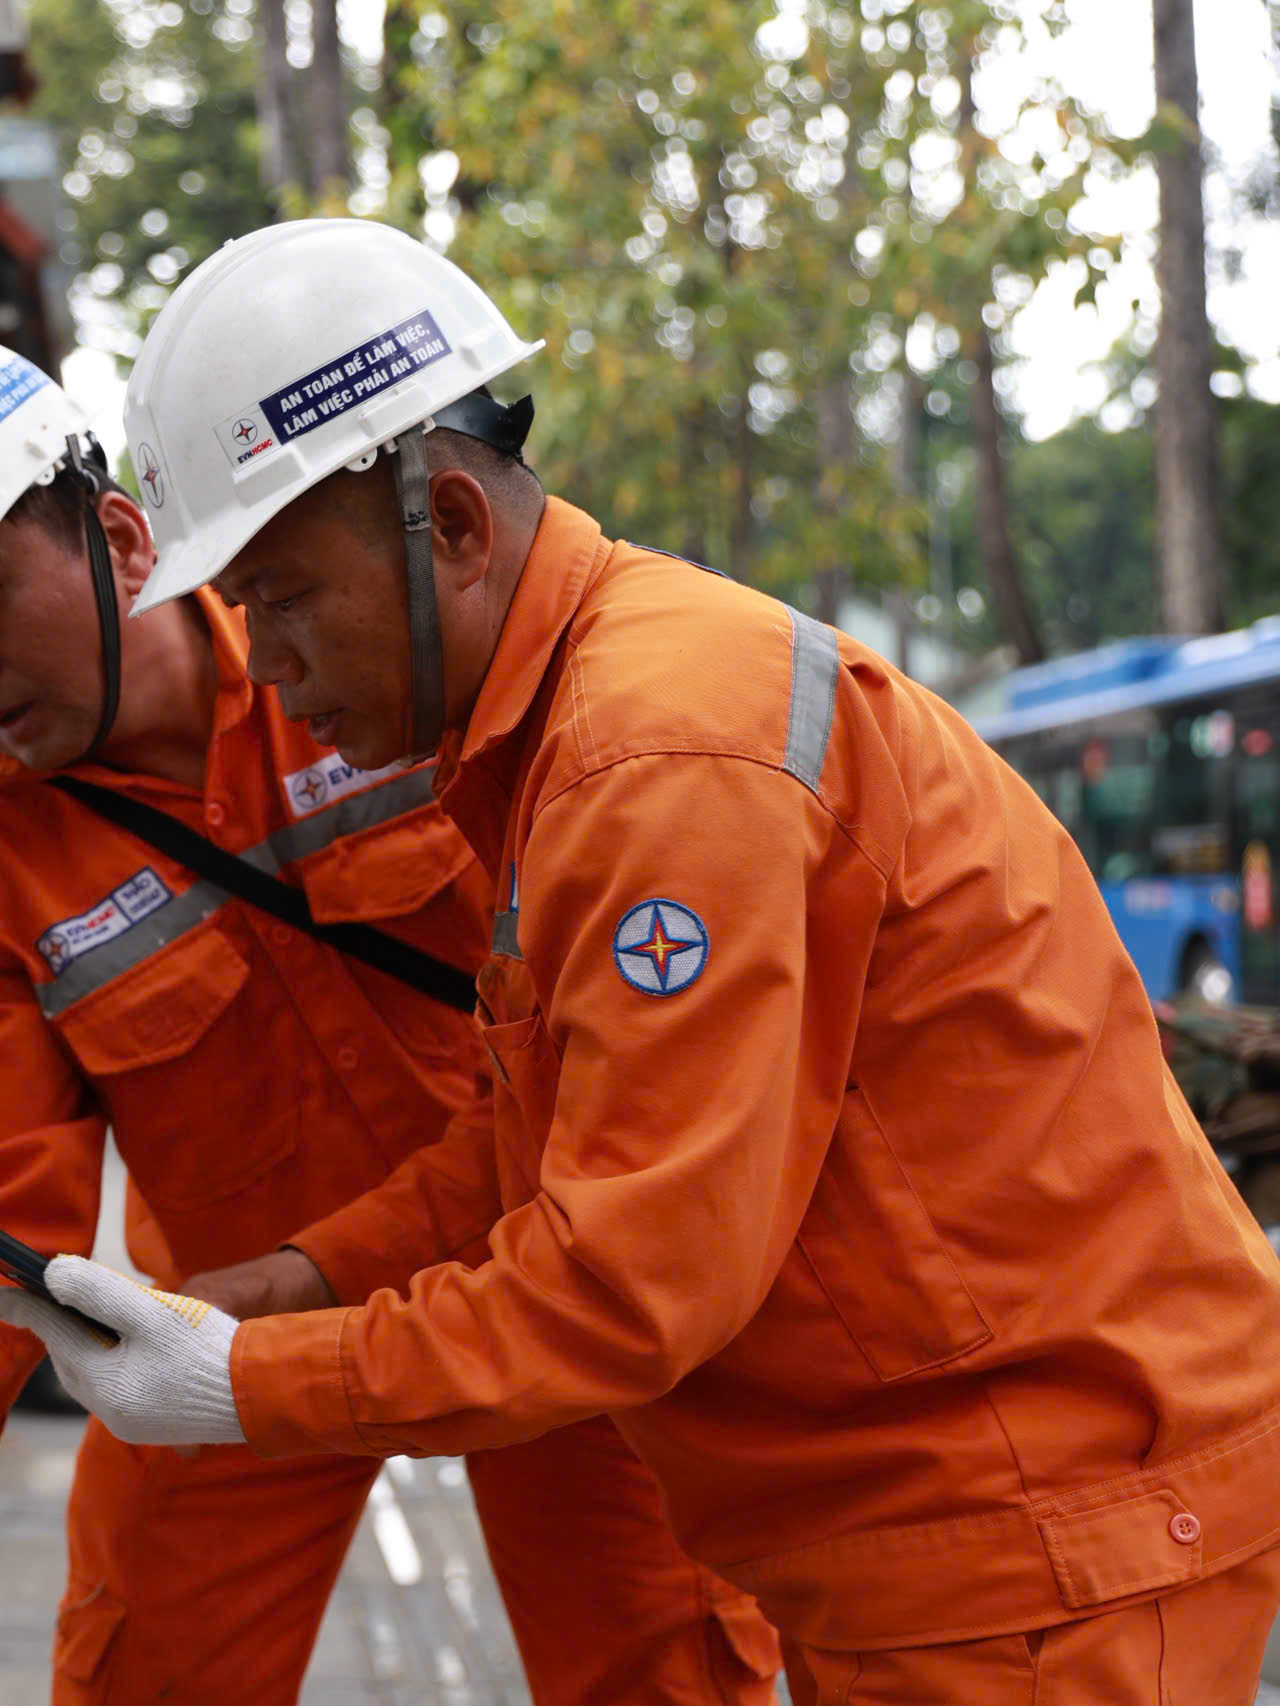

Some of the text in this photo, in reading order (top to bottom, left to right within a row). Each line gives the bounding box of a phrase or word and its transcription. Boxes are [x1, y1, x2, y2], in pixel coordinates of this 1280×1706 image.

[280, 391, 304, 412] AN
[302, 367, 344, 399] TOÀN
[344, 351, 366, 377] ĐỂ
[365, 340, 397, 365] LÀM
[283, 339, 445, 436] LÀM VIỆC PHẢI AN TOÀN
[237, 438, 273, 465] EVNHCMC
